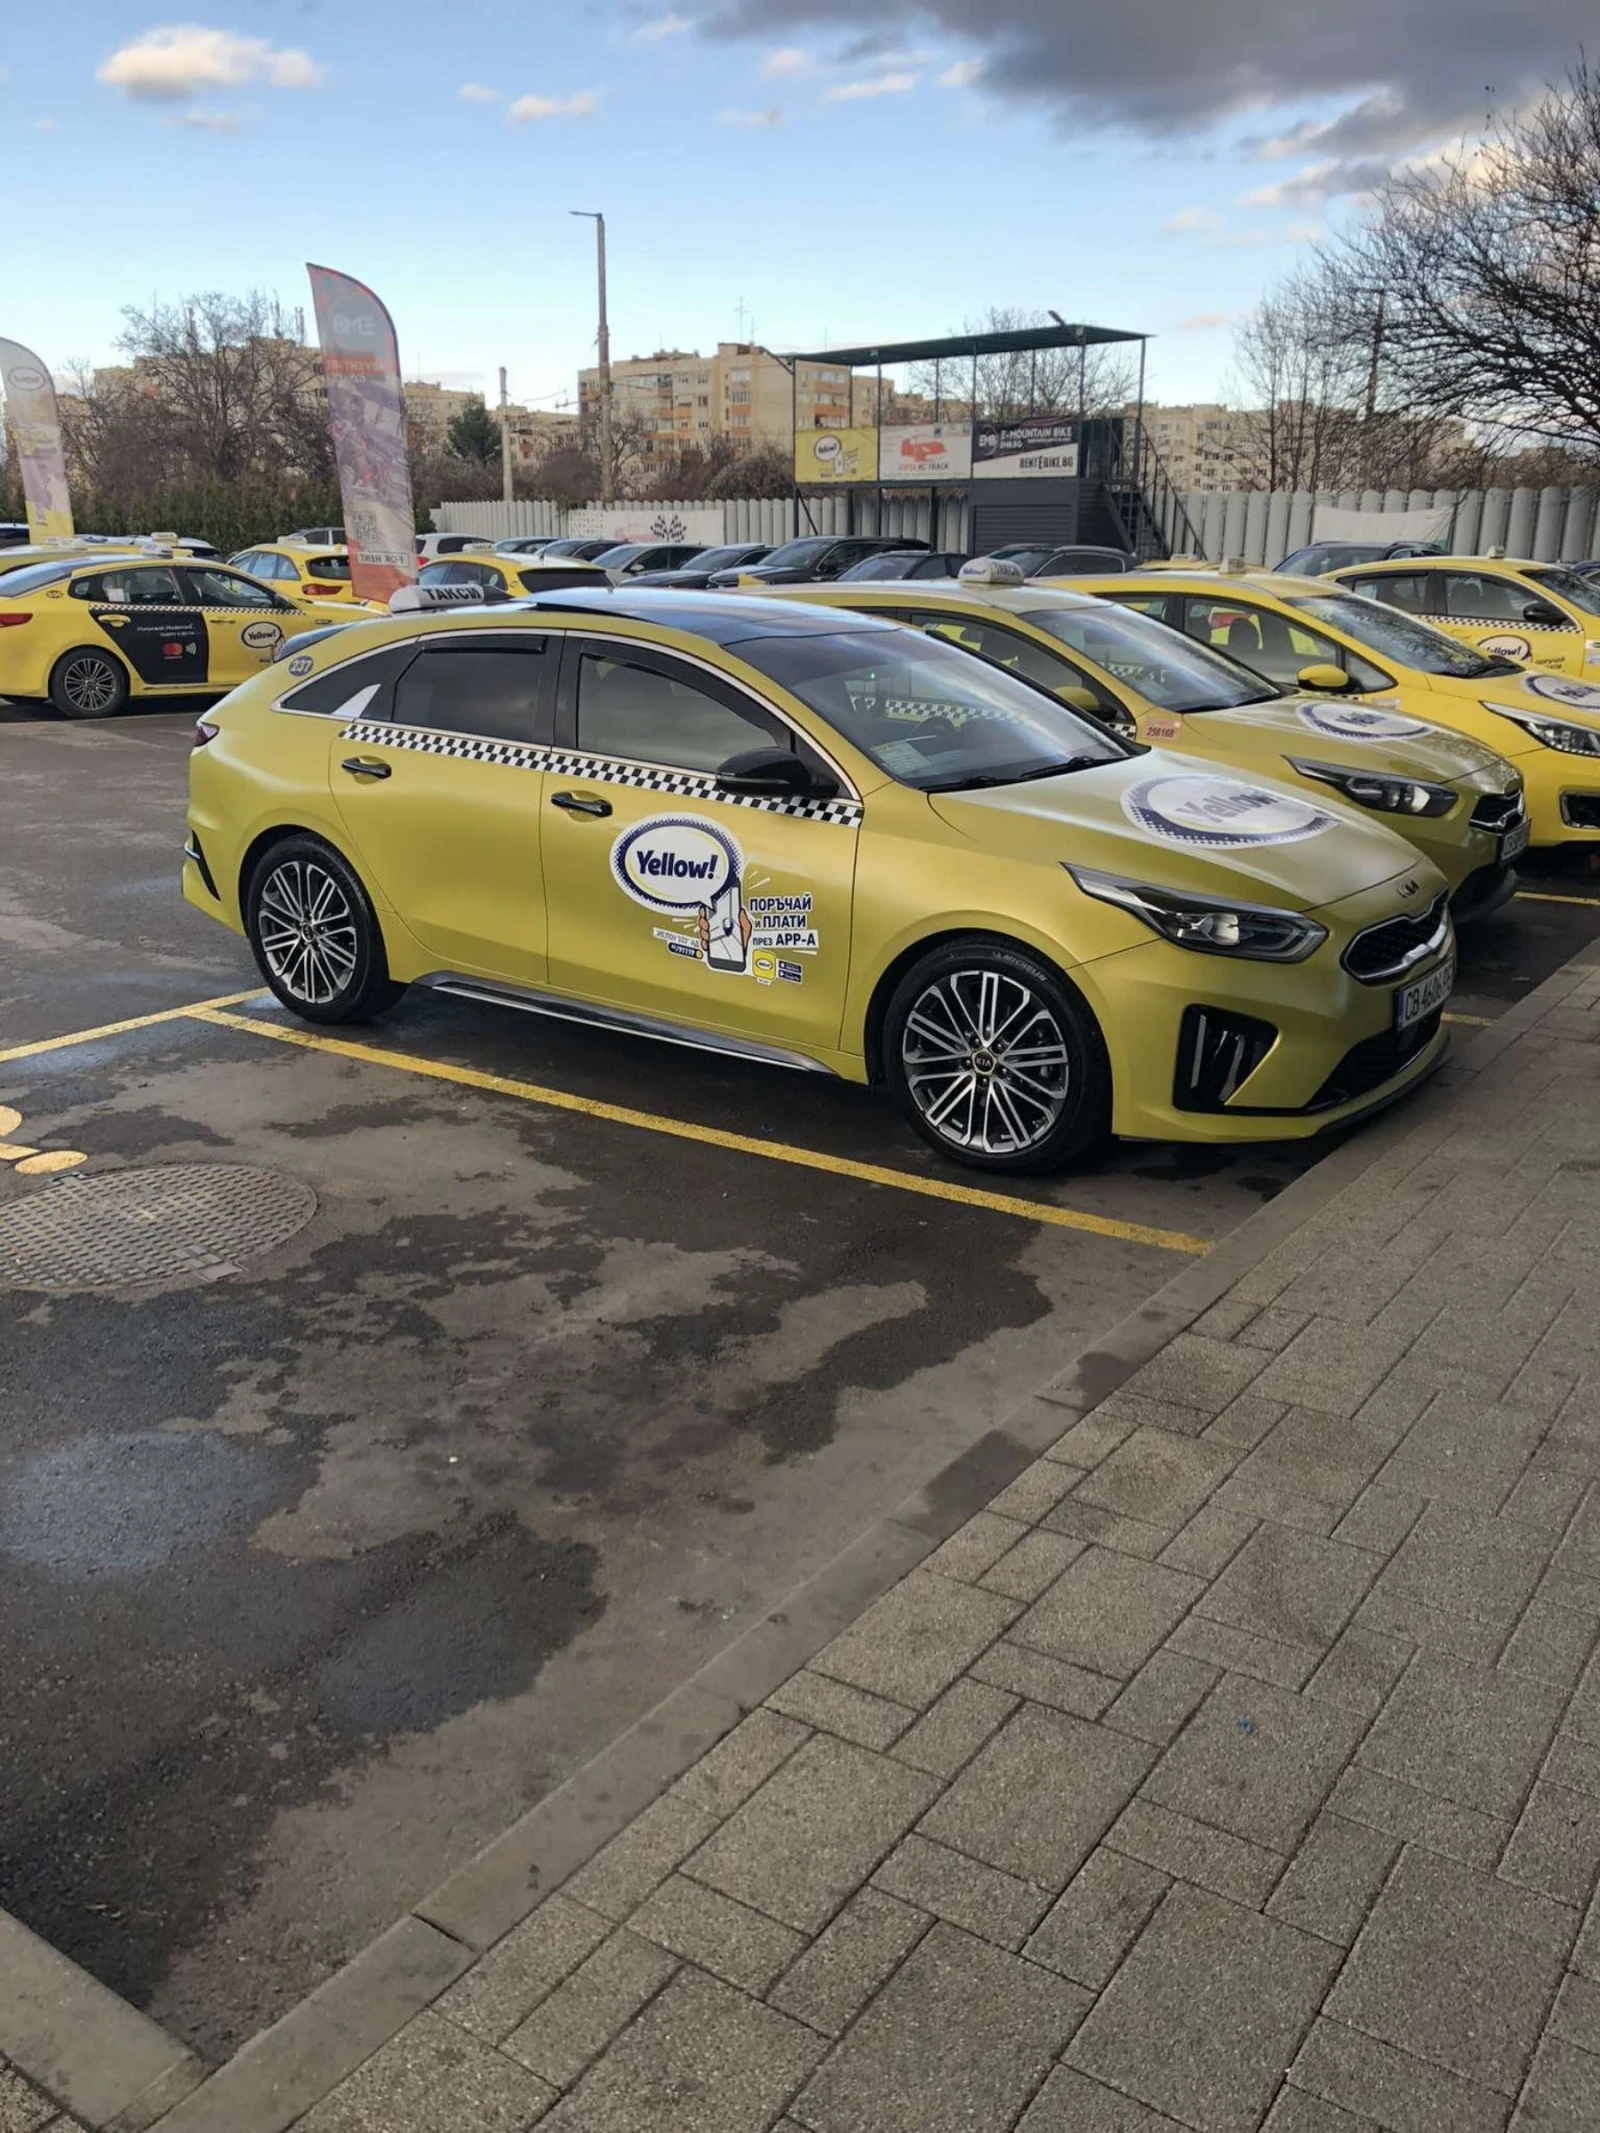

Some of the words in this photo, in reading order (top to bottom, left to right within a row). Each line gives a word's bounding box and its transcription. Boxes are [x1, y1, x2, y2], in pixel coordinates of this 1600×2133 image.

[1000, 427, 1051, 439] E-MOUNTAIN
[1053, 426, 1072, 437] BIKE
[928, 462, 949, 470] TRACK
[421, 586, 484, 601] ТАКСИ
[290, 659, 312, 672] 237
[636, 850, 719, 880] Yellow!
[750, 894, 812, 911] ПОРЪЧАЙ
[763, 915, 806, 928] ПЛАТИ
[976, 1057, 992, 1067] KIA
